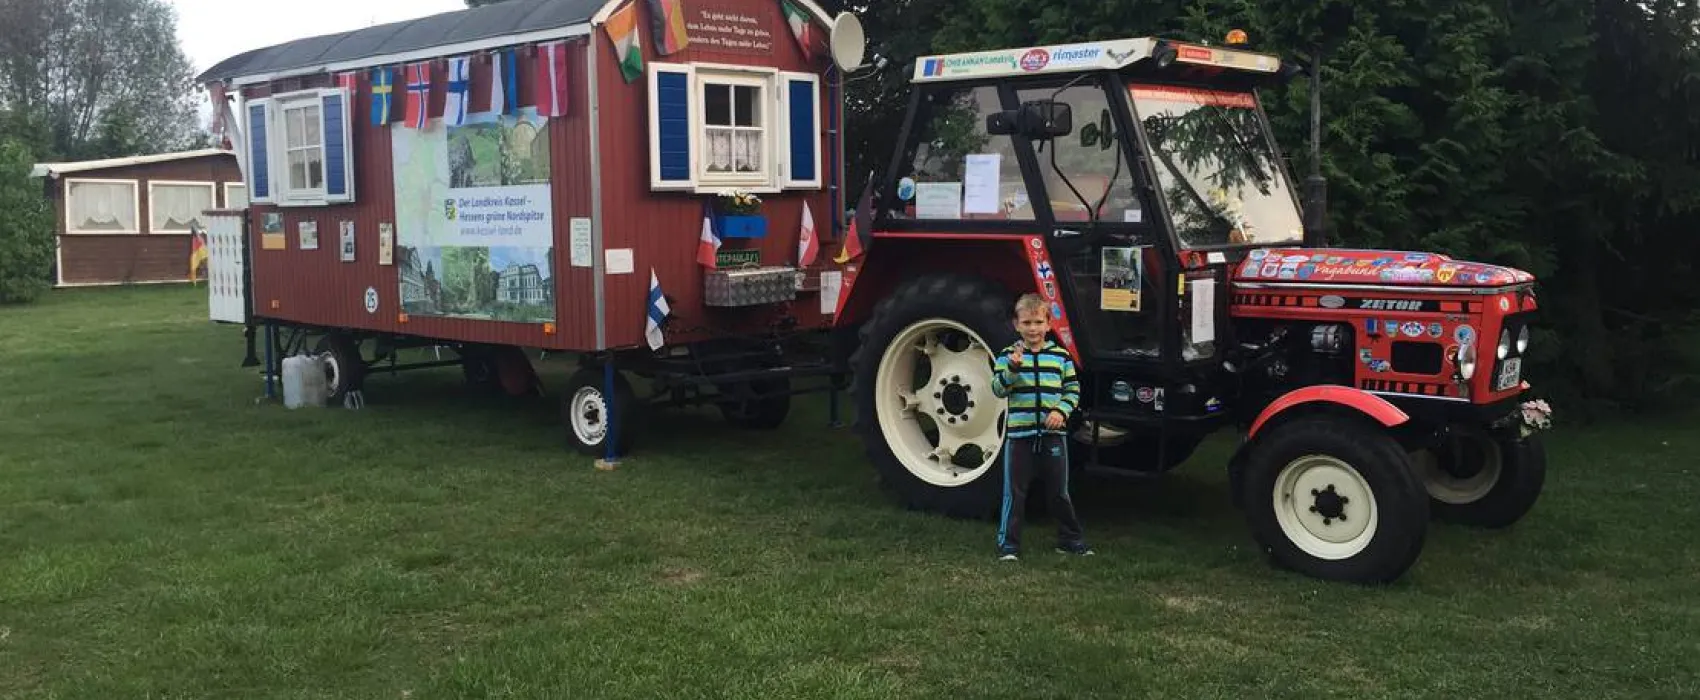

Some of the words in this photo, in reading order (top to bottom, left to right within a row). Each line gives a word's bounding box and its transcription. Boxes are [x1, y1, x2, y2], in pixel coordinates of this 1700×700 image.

[1053, 49, 1100, 61] rimaster
[458, 198, 471, 208] Der
[471, 196, 504, 207] Landkreis
[504, 195, 527, 206] Kassel
[459, 212, 485, 222] Hessens
[485, 211, 506, 224] grüne
[506, 209, 545, 223] Nordspitze
[1359, 299, 1423, 311] ZETOR
